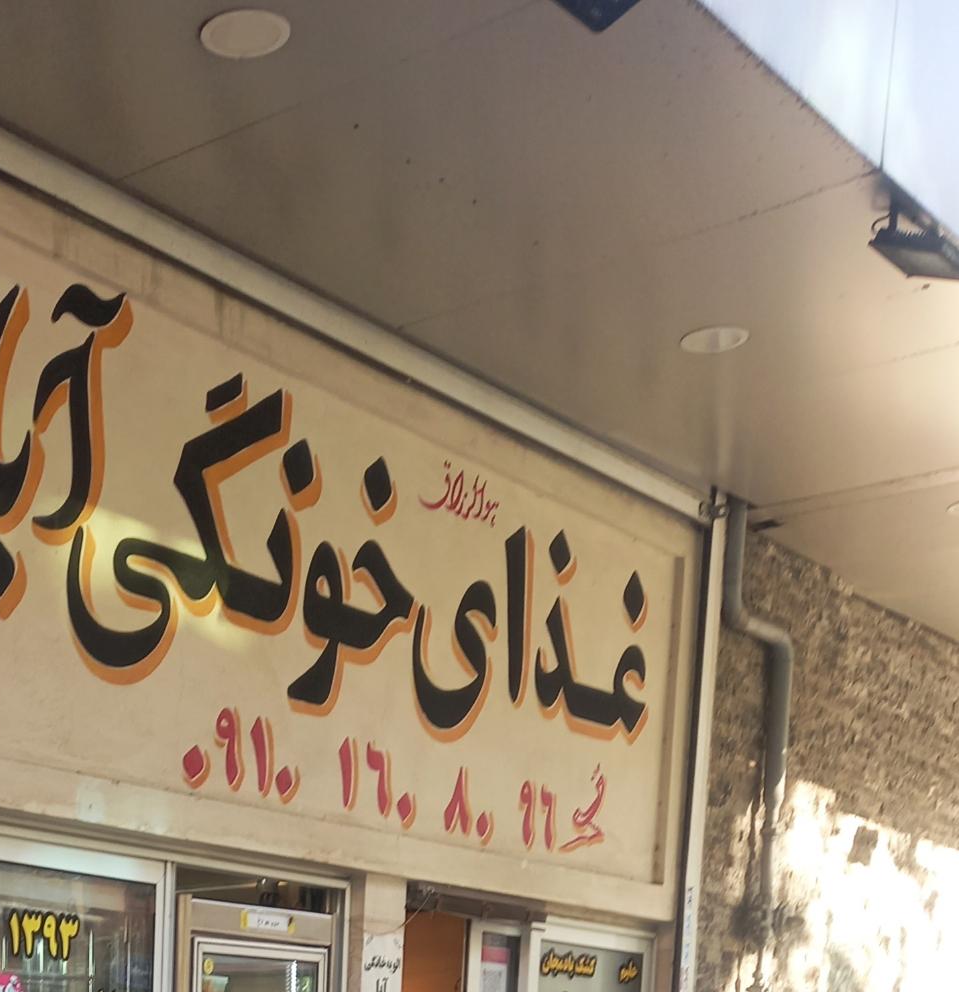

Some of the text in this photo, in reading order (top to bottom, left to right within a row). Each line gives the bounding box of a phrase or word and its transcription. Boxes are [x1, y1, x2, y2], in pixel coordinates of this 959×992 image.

[66, 372, 651, 744] غذای خونگی
[8, 908, 80, 960] ۱۳۹۳
